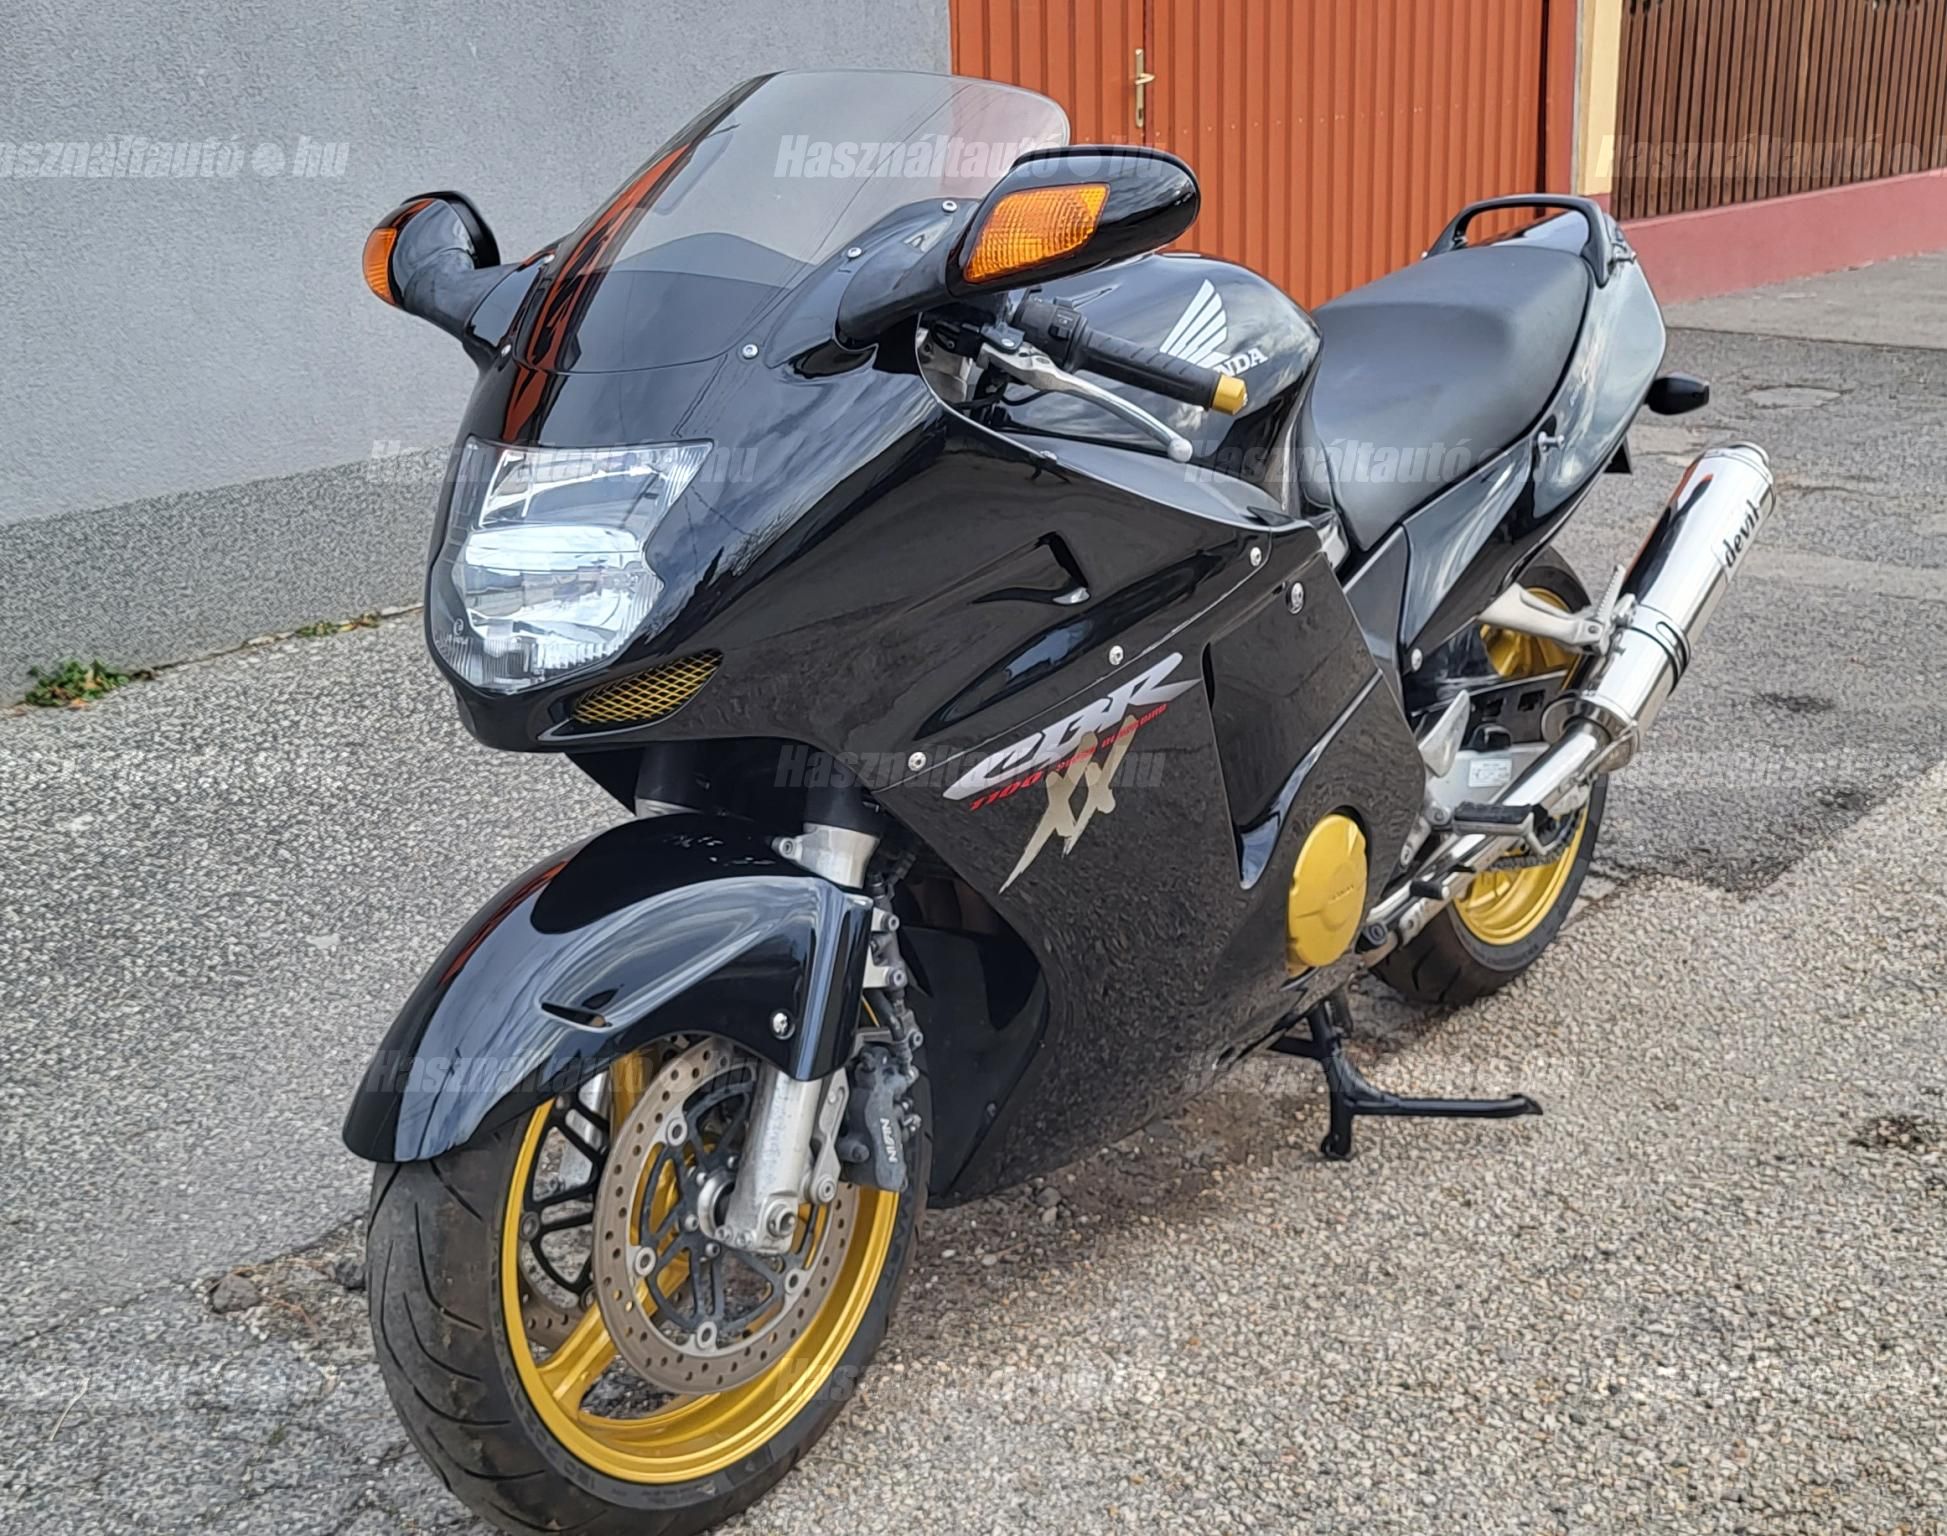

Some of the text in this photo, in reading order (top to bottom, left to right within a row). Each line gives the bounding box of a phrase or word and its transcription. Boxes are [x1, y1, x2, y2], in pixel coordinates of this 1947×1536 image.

[1212, 347, 1269, 377] NDA
[1722, 499, 1760, 568] devil
[943, 652, 1203, 800] CBR
[969, 770, 1045, 811] 1100
[999, 714, 1139, 895] XX
